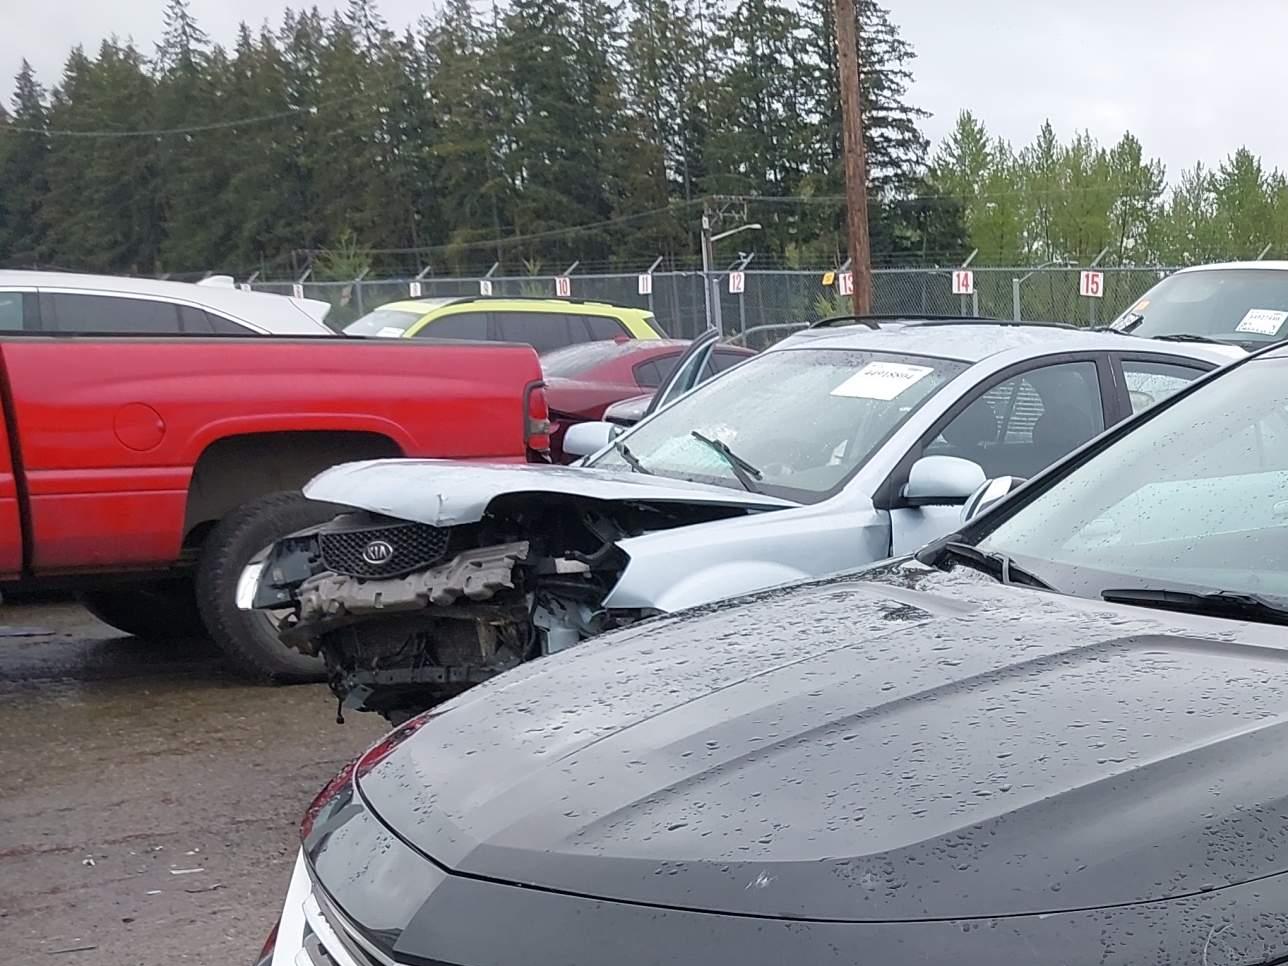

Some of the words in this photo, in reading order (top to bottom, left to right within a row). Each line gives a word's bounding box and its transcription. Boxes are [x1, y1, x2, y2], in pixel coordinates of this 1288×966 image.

[558, 279, 568, 296] 10
[640, 275, 650, 293] 11
[732, 273, 742, 291] 12
[955, 272, 970, 293] 14
[1085, 272, 1099, 294] 15
